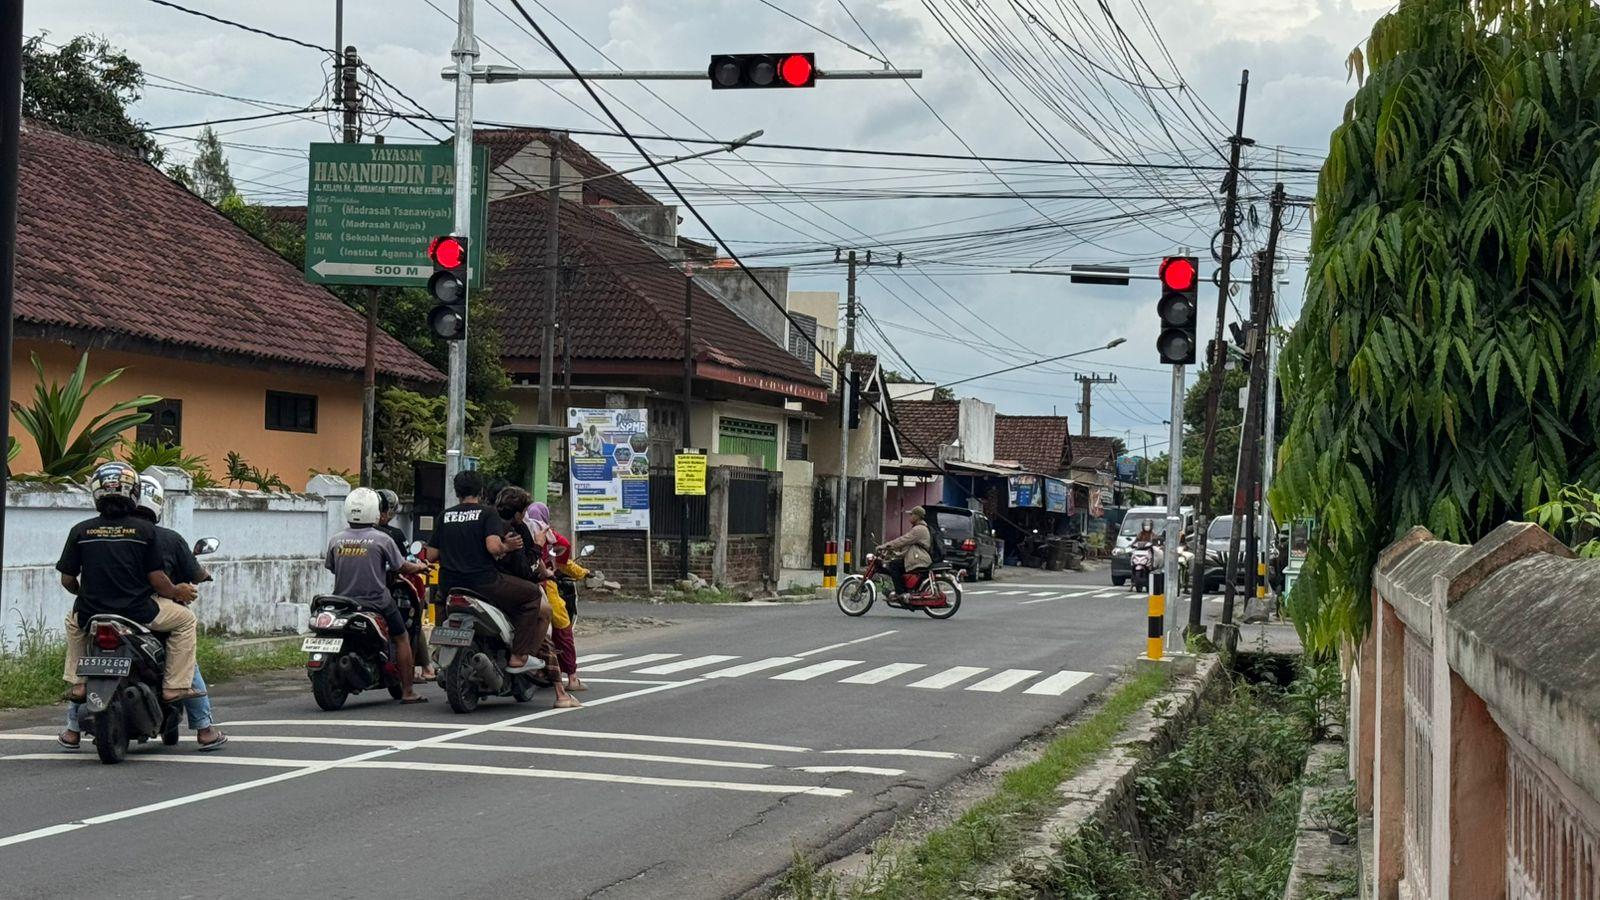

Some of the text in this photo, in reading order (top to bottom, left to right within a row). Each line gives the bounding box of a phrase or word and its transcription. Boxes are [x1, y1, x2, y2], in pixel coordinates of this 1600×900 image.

[371, 148, 423, 161] YAYASAN
[314, 161, 479, 186] HASANUDDIN PAE
[342, 204, 391, 215] (Madrasah
[393, 206, 452, 218] Tsanawiyah)
[341, 218, 391, 229] (Madrasah
[392, 221, 426, 231] Aliyah)
[314, 232, 333, 241] SMK
[341, 232, 380, 242] (Sekolah
[381, 235, 427, 245] Menengah
[340, 246, 378, 257] (Institut
[381, 249, 413, 259] Agama
[375, 265, 418, 276] 500 M
[620, 422, 646, 433] SPMB
[78, 658, 129, 667] AG 5192 ECB
